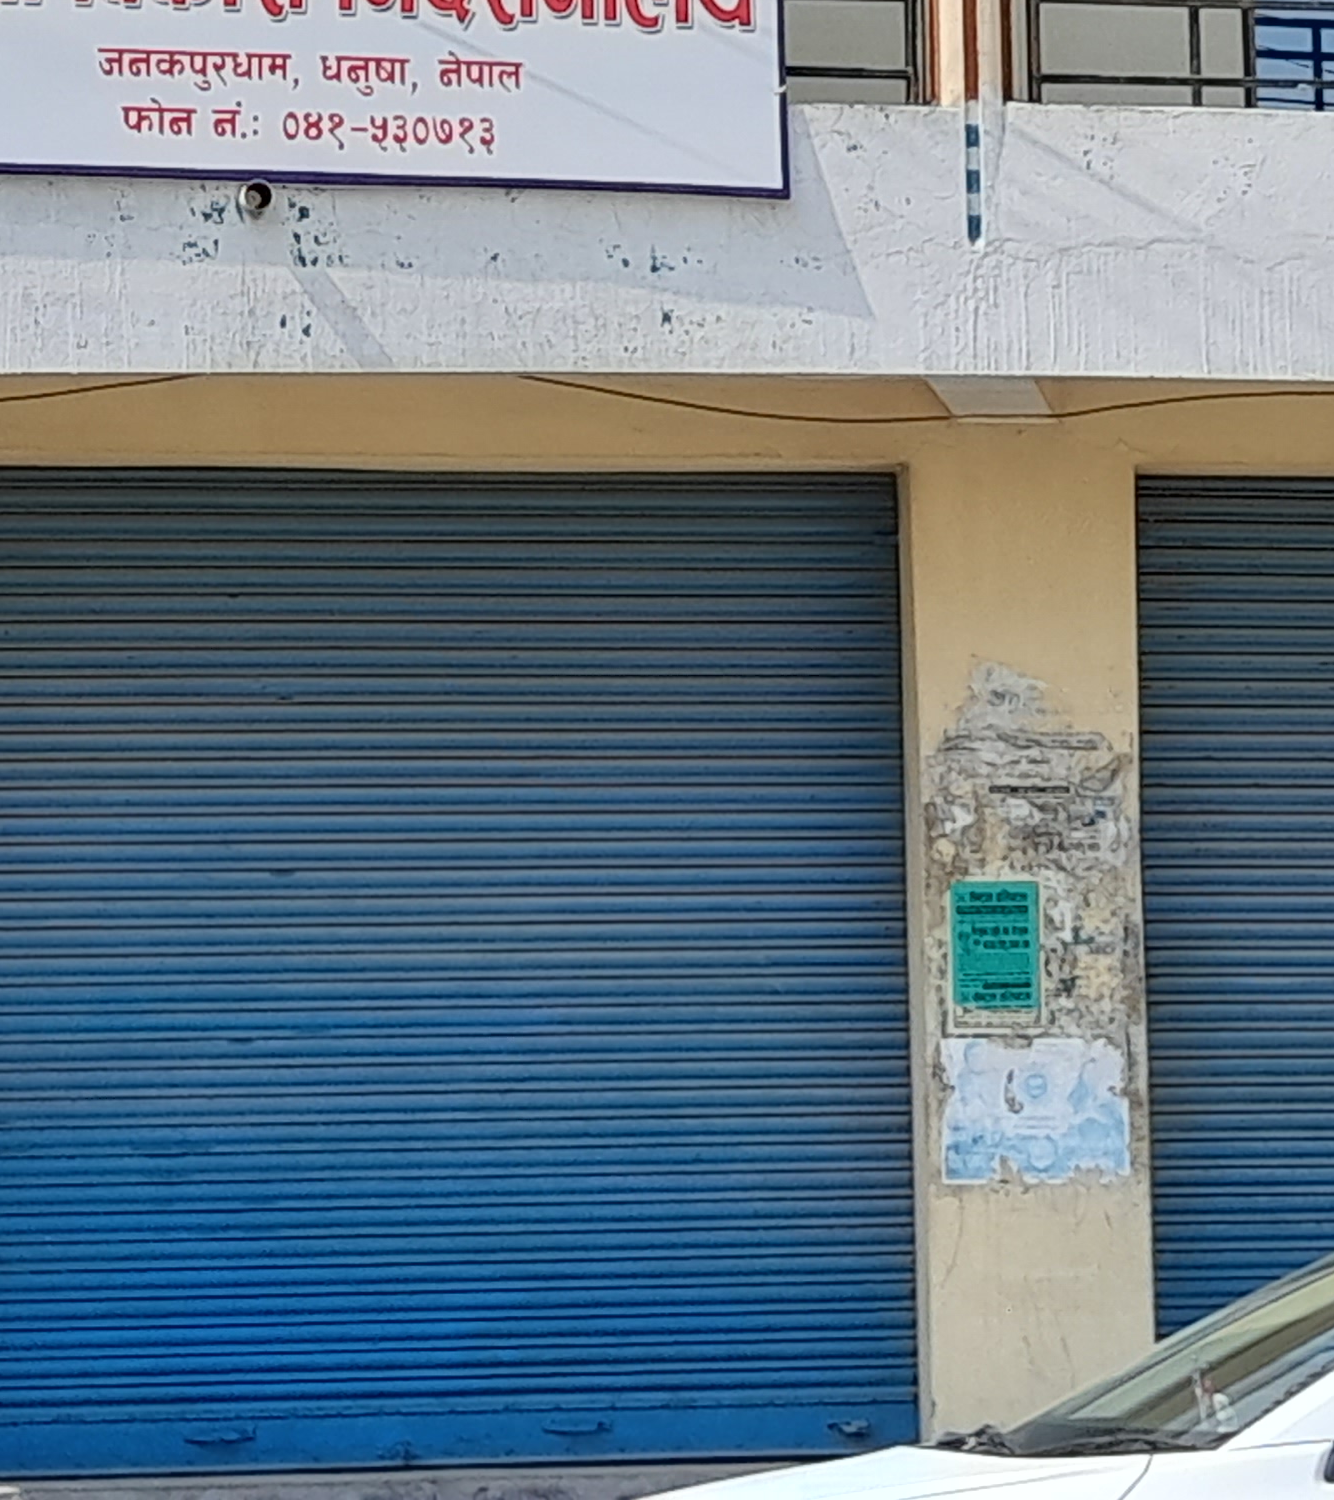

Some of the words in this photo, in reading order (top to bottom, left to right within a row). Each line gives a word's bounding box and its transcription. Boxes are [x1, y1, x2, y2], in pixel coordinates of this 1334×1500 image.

[98, 47, 300, 91] जनकपुरधाम,
[320, 54, 419, 96] धनुषा,
[438, 50, 523, 92] नेपाल
[122, 98, 197, 137] फोन
[282, 111, 496, 155] ०४१-५३०७१३
